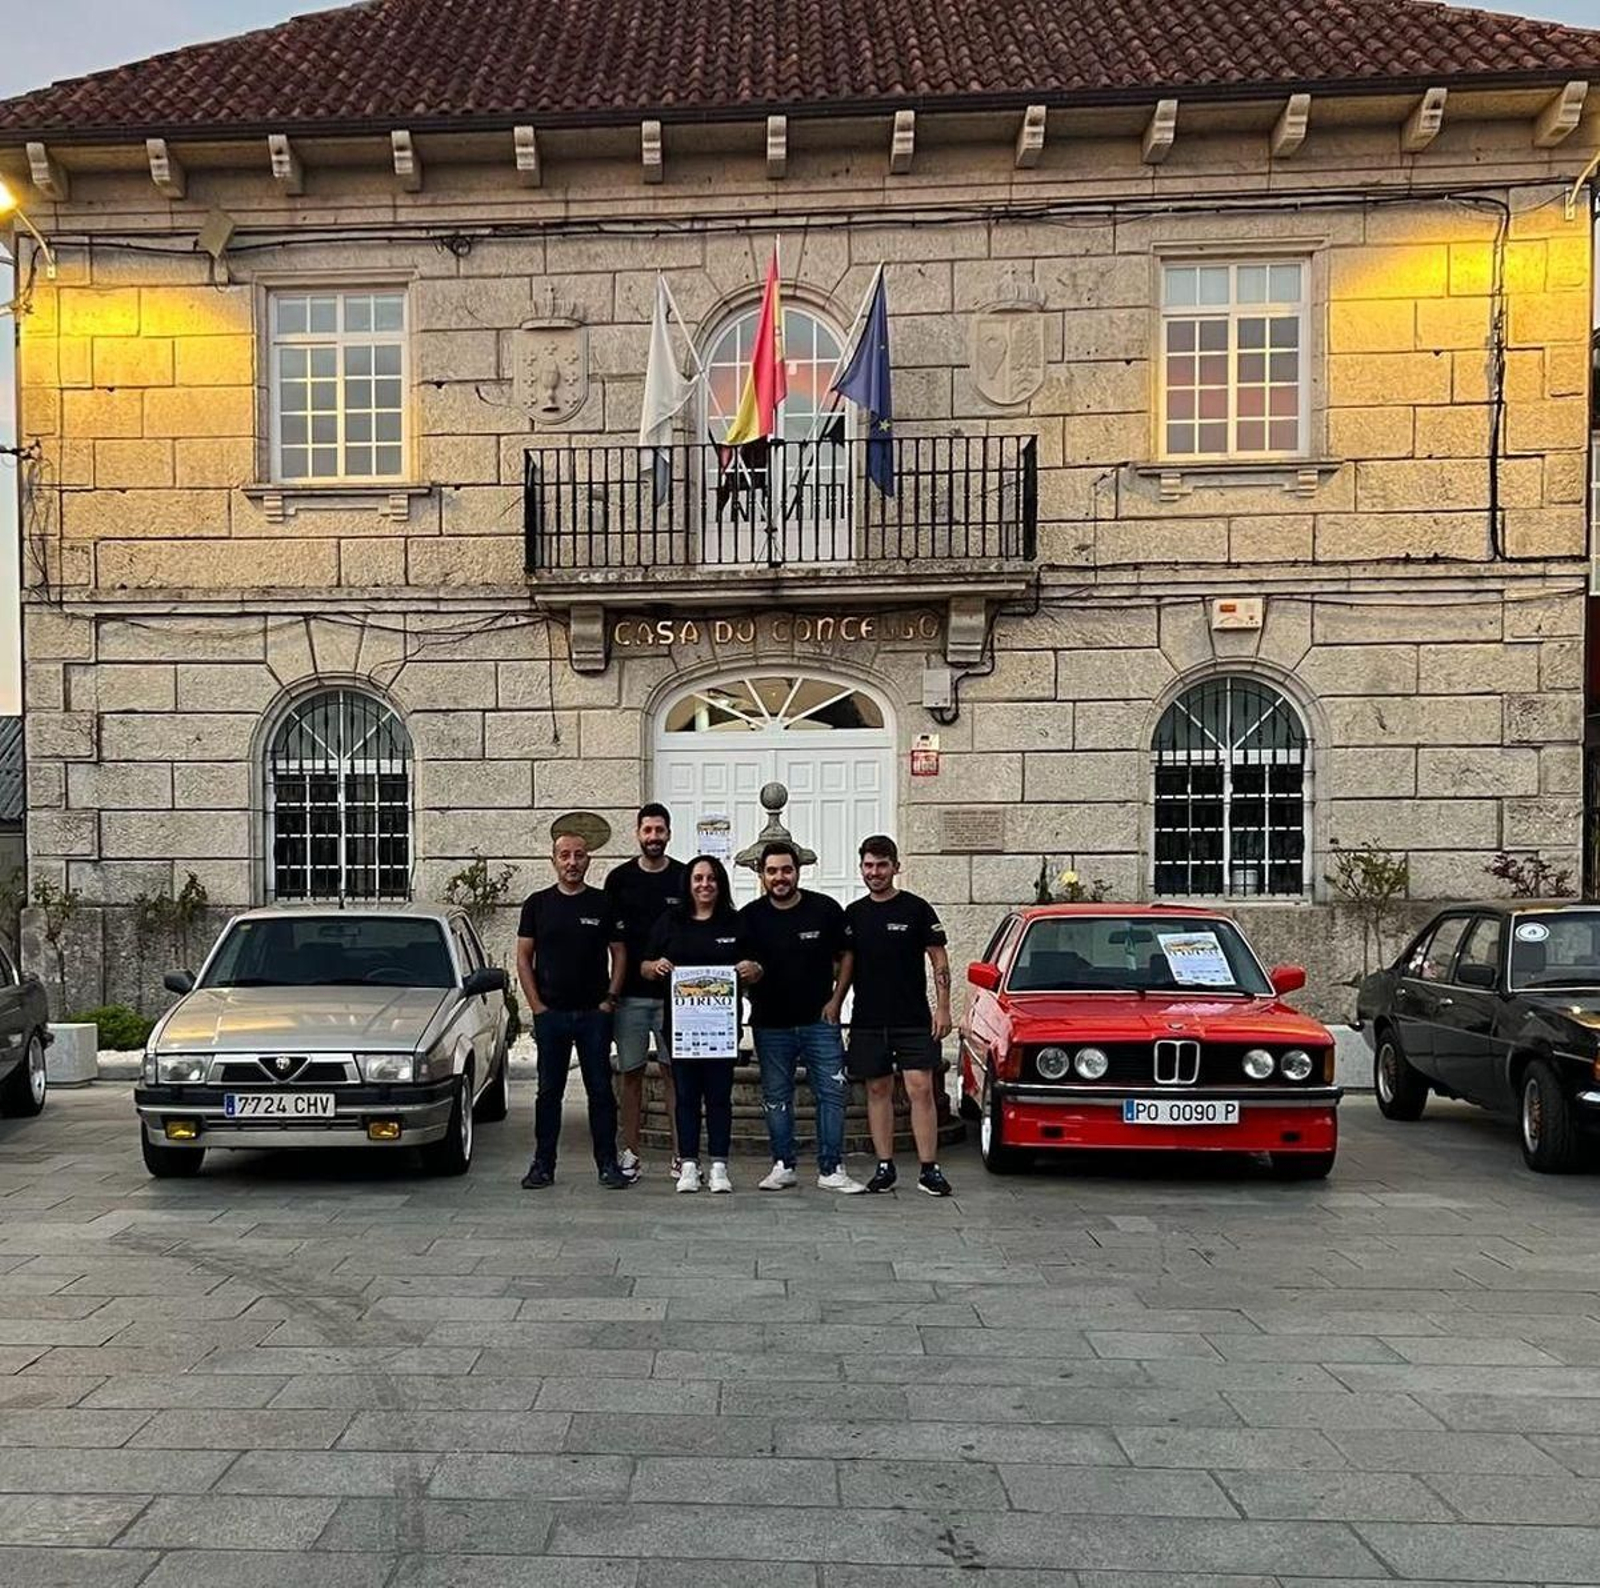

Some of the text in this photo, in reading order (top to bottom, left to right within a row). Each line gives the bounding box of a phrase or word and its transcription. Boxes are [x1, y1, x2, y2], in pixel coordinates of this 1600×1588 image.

[614, 620, 699, 645] CASA
[238, 1096, 330, 1114] 7724 CHV
[1136, 1103, 1236, 1121] PO 0090 P
